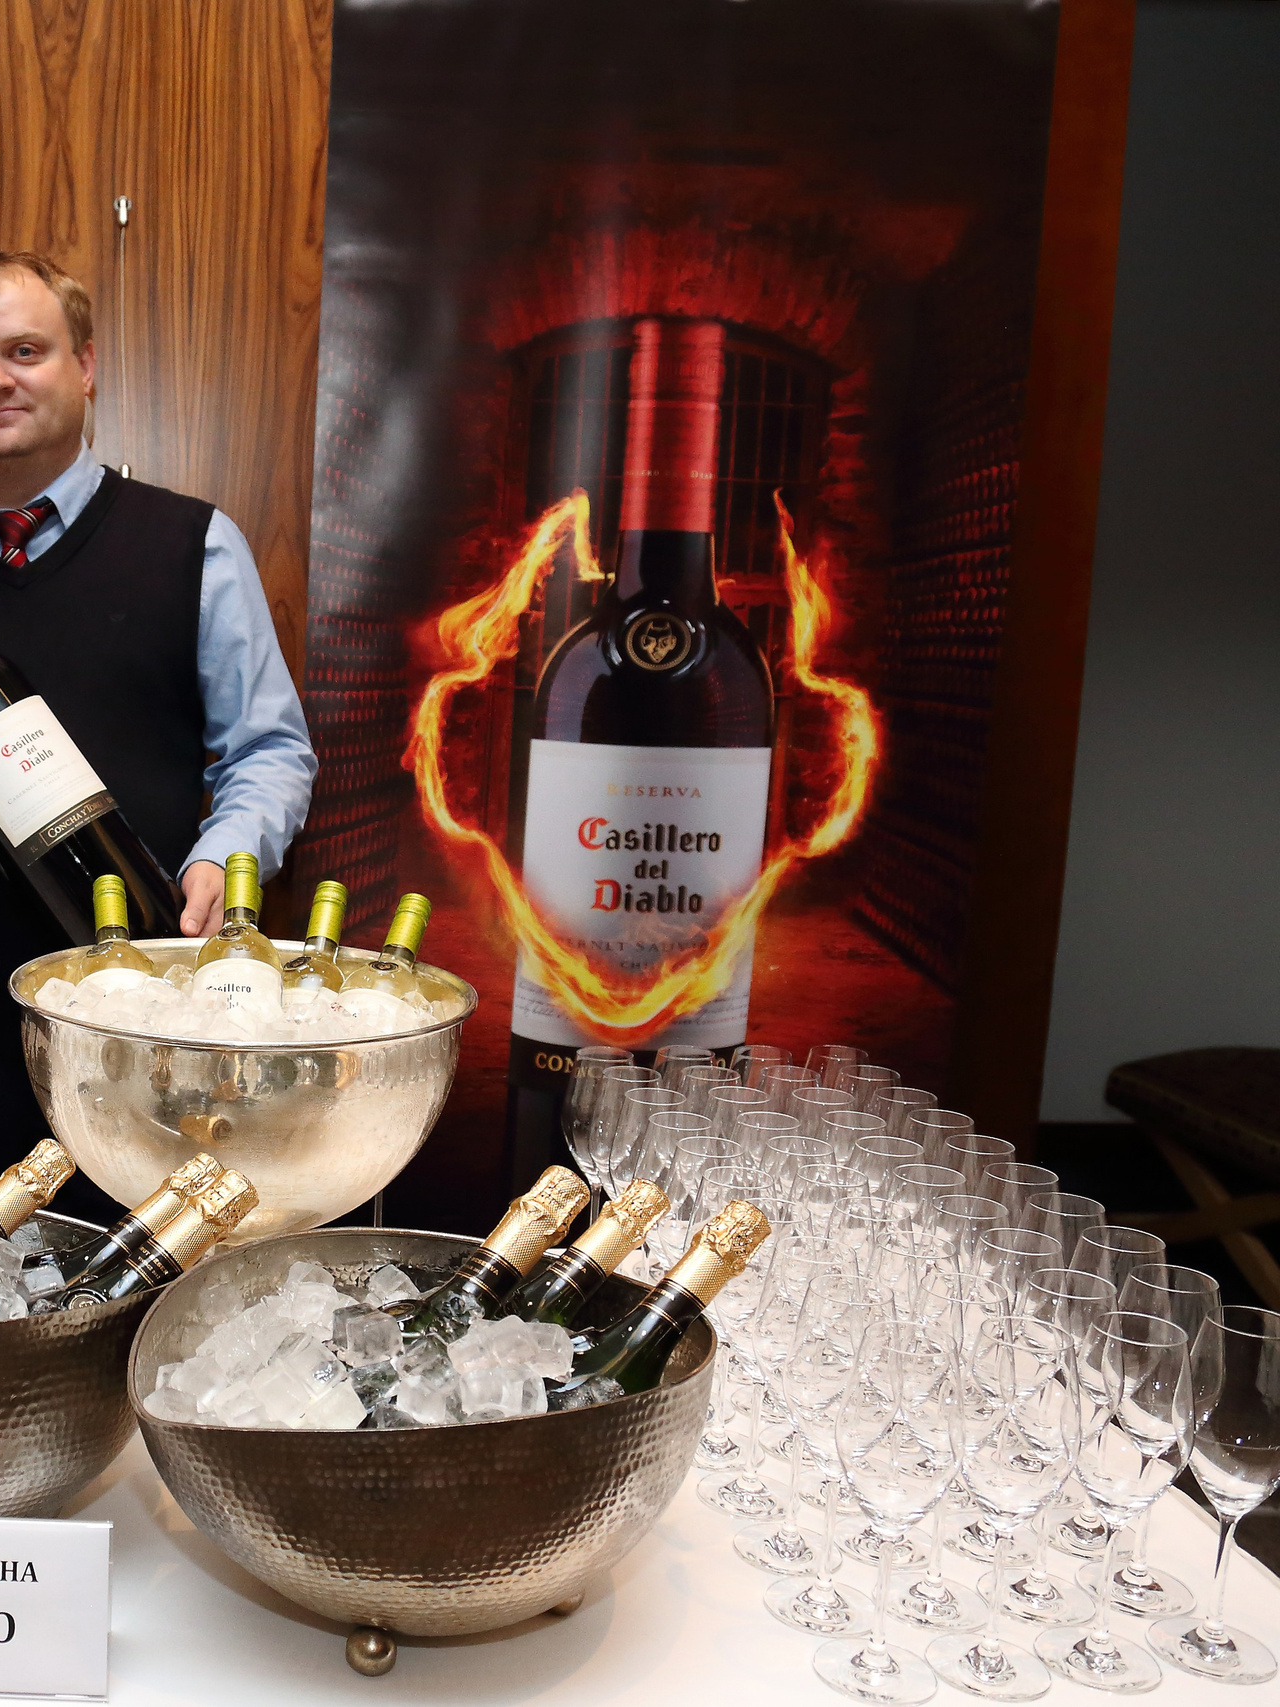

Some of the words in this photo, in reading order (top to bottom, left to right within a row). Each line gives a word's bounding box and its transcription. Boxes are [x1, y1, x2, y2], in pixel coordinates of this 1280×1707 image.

[1, 729, 44, 757] Casillero
[26, 745, 37, 755] del
[19, 748, 54, 773] Diablo
[606, 783, 702, 798] RESERVA
[578, 817, 721, 852] Casillero
[634, 859, 669, 879] del
[591, 879, 702, 912] Diablo
